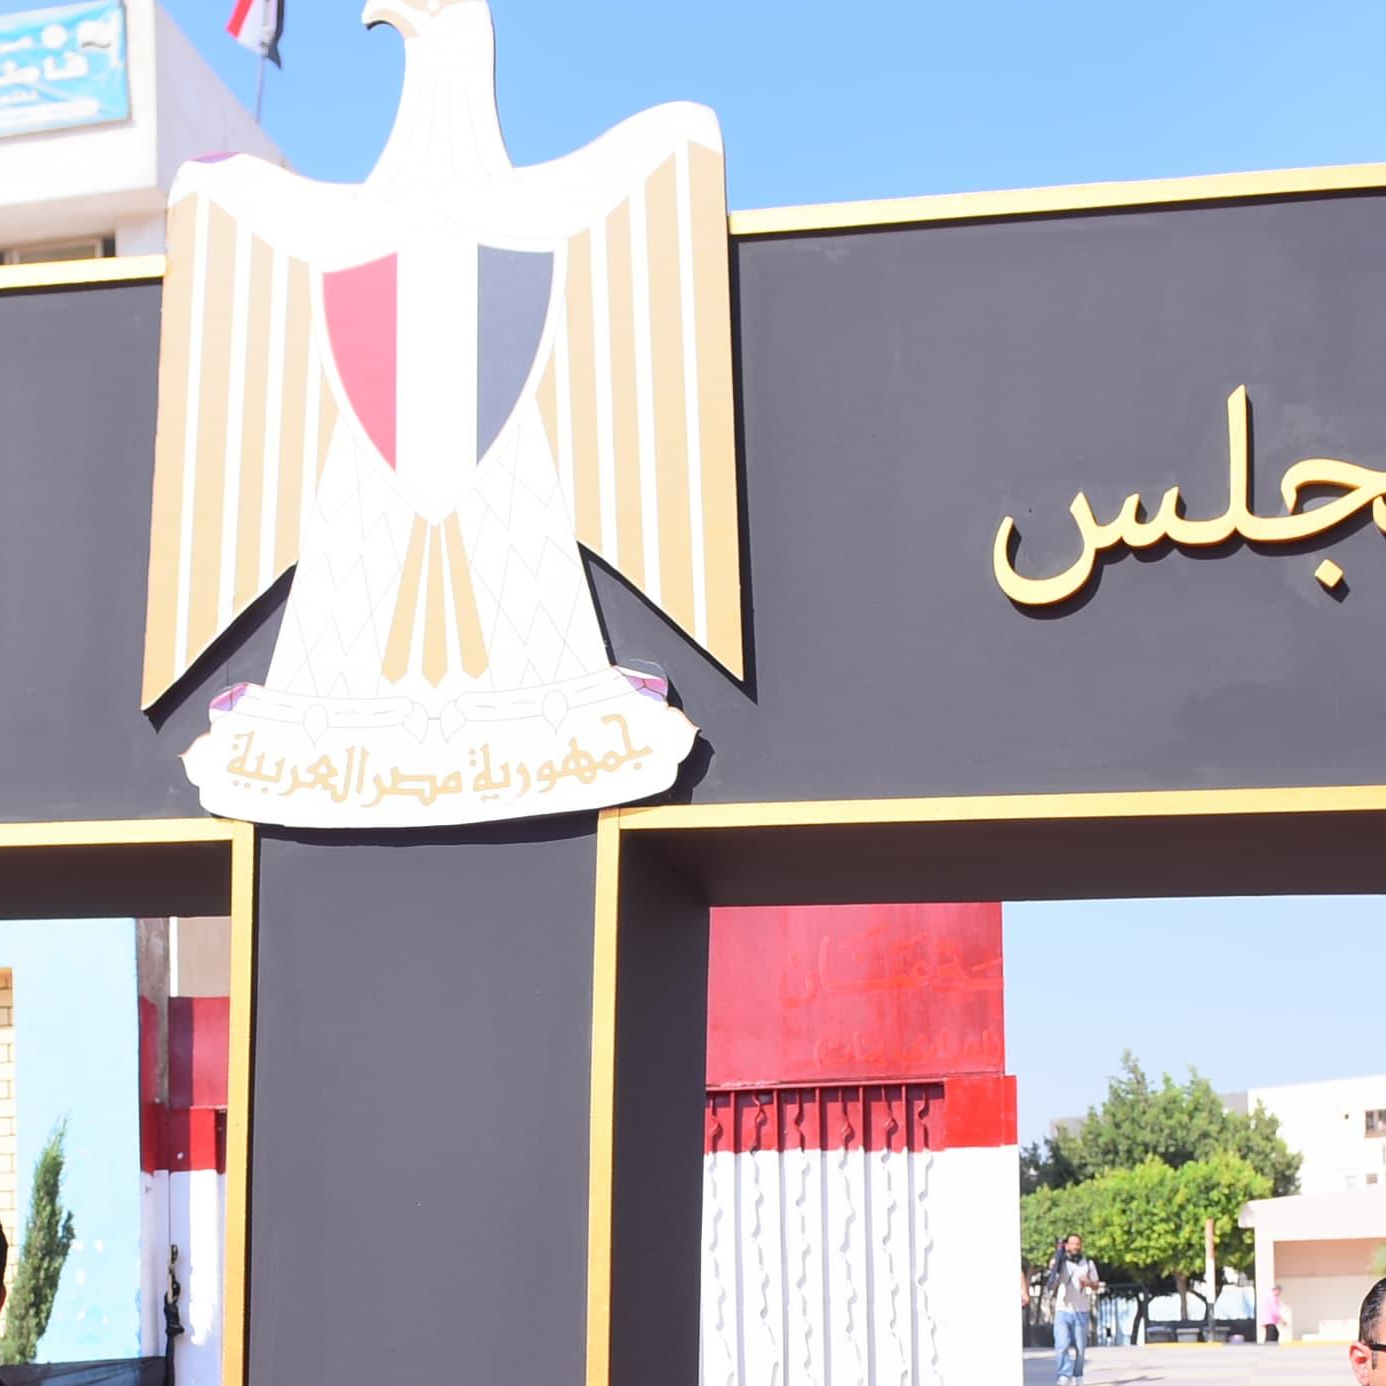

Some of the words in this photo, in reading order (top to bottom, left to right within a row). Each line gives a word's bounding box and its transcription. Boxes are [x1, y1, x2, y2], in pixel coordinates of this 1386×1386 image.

[226, 729, 370, 805] العربية
[360, 765, 463, 809] مصر
[471, 713, 653, 802] جمهورية
